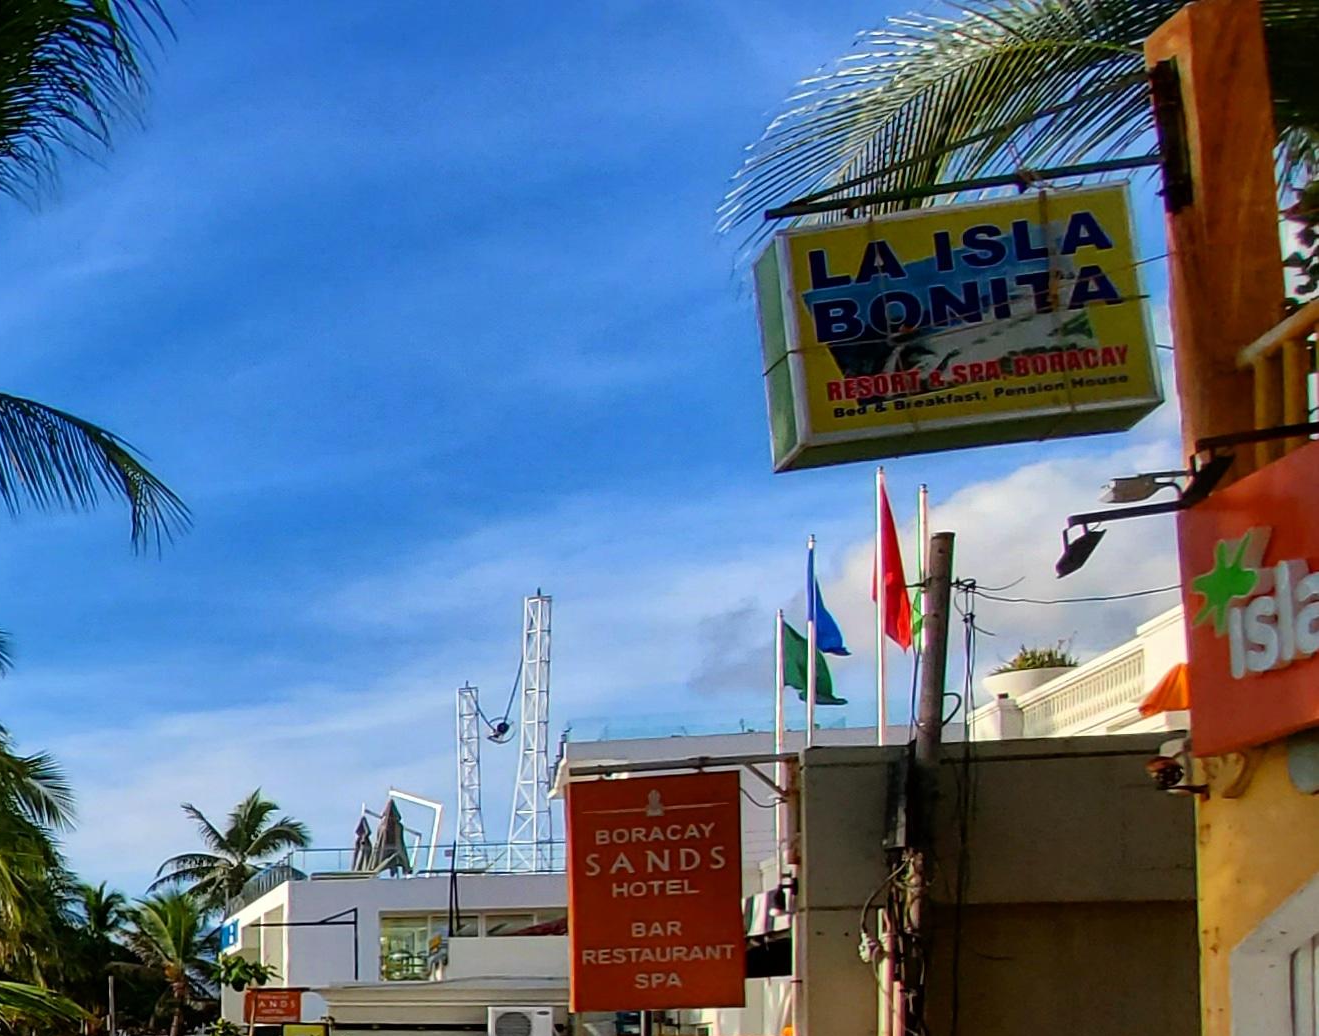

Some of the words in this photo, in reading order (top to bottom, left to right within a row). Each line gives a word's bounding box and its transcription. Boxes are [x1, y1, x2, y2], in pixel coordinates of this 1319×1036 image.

[808, 240, 908, 290] LA
[933, 211, 1113, 273] ISLA
[812, 264, 1125, 344] BONITA
[827, 371, 922, 402] RESORT
[928, 367, 946, 388] &
[1014, 344, 1129, 378] BORACAY
[833, 403, 868, 419] Bed
[874, 399, 888, 414] &
[993, 380, 1066, 399] Pension
[1071, 373, 1129, 389] House
[595, 822, 715, 845] BORACAY
[585, 846, 726, 877] SANDS
[612, 879, 701, 898] HOTEL
[631, 920, 682, 938] BAR
[582, 944, 735, 965] RESTAURANT
[634, 972, 682, 989] SPA
[255, 1000, 297, 1009] ANDS
